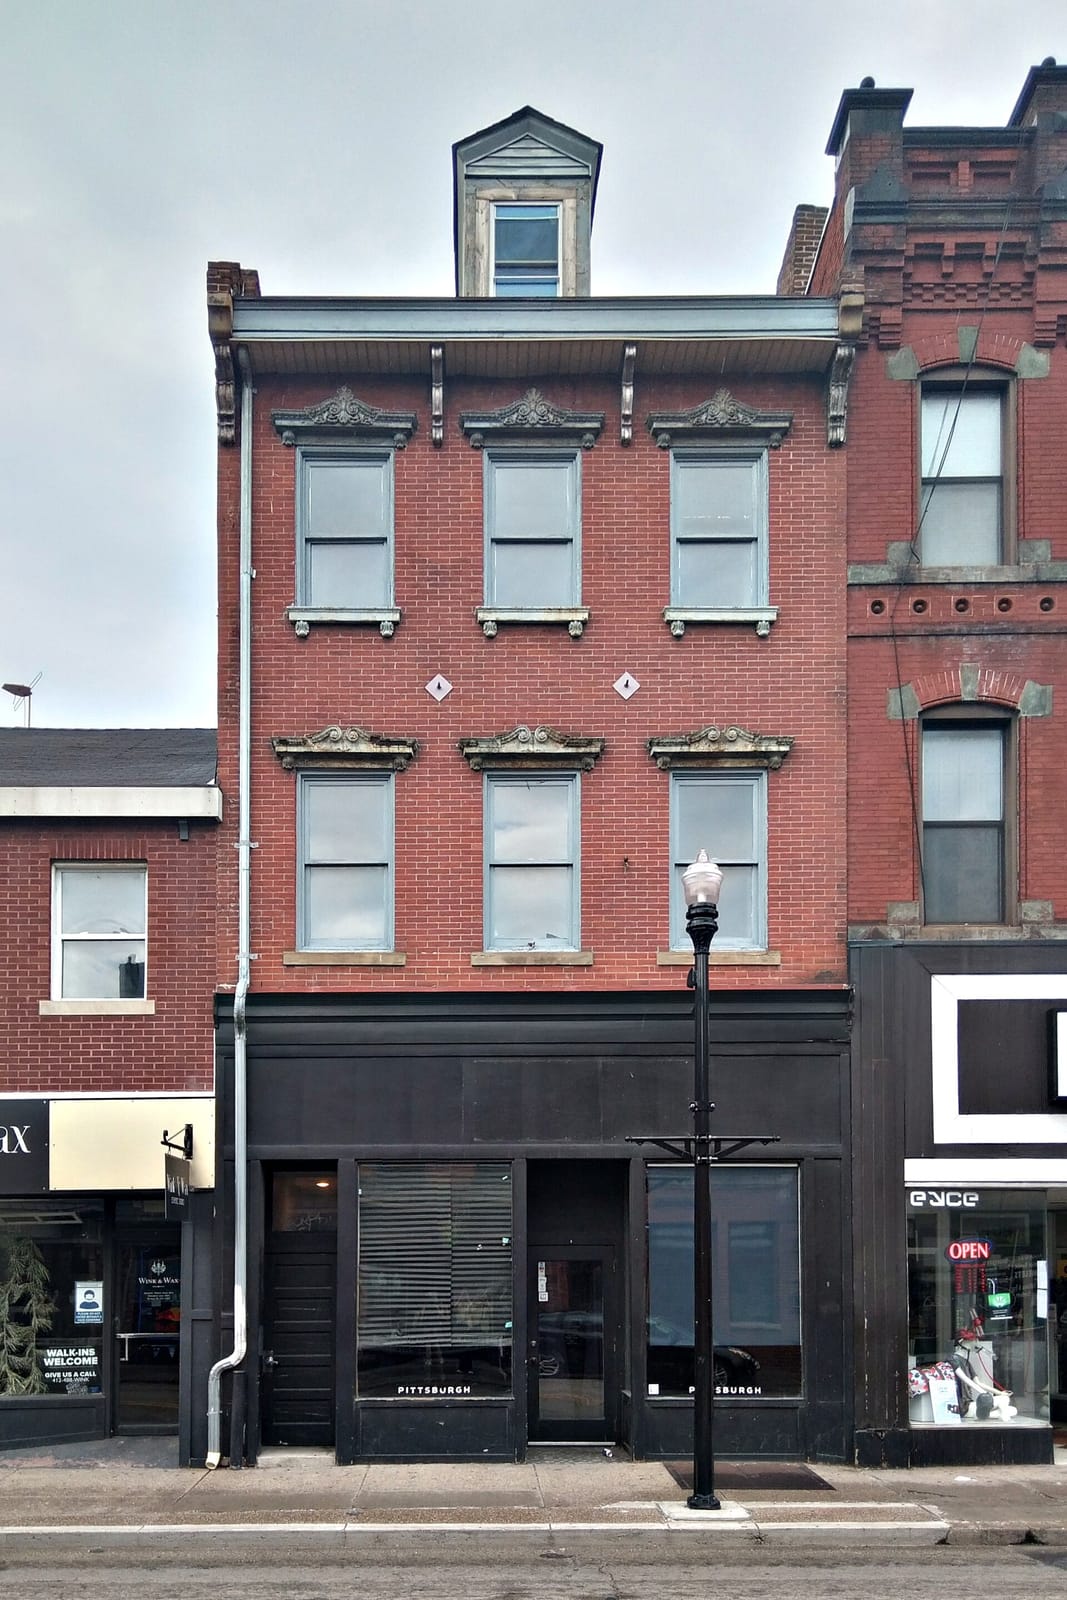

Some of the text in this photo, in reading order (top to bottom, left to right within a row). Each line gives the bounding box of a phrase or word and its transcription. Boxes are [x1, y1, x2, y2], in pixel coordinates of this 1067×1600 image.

[949, 1242, 989, 1260] OPEN
[43, 1357, 98, 1366] WELCOME
[397, 1386, 471, 1394] PITTSBURGH
[688, 1386, 762, 1394] PSBURGH
